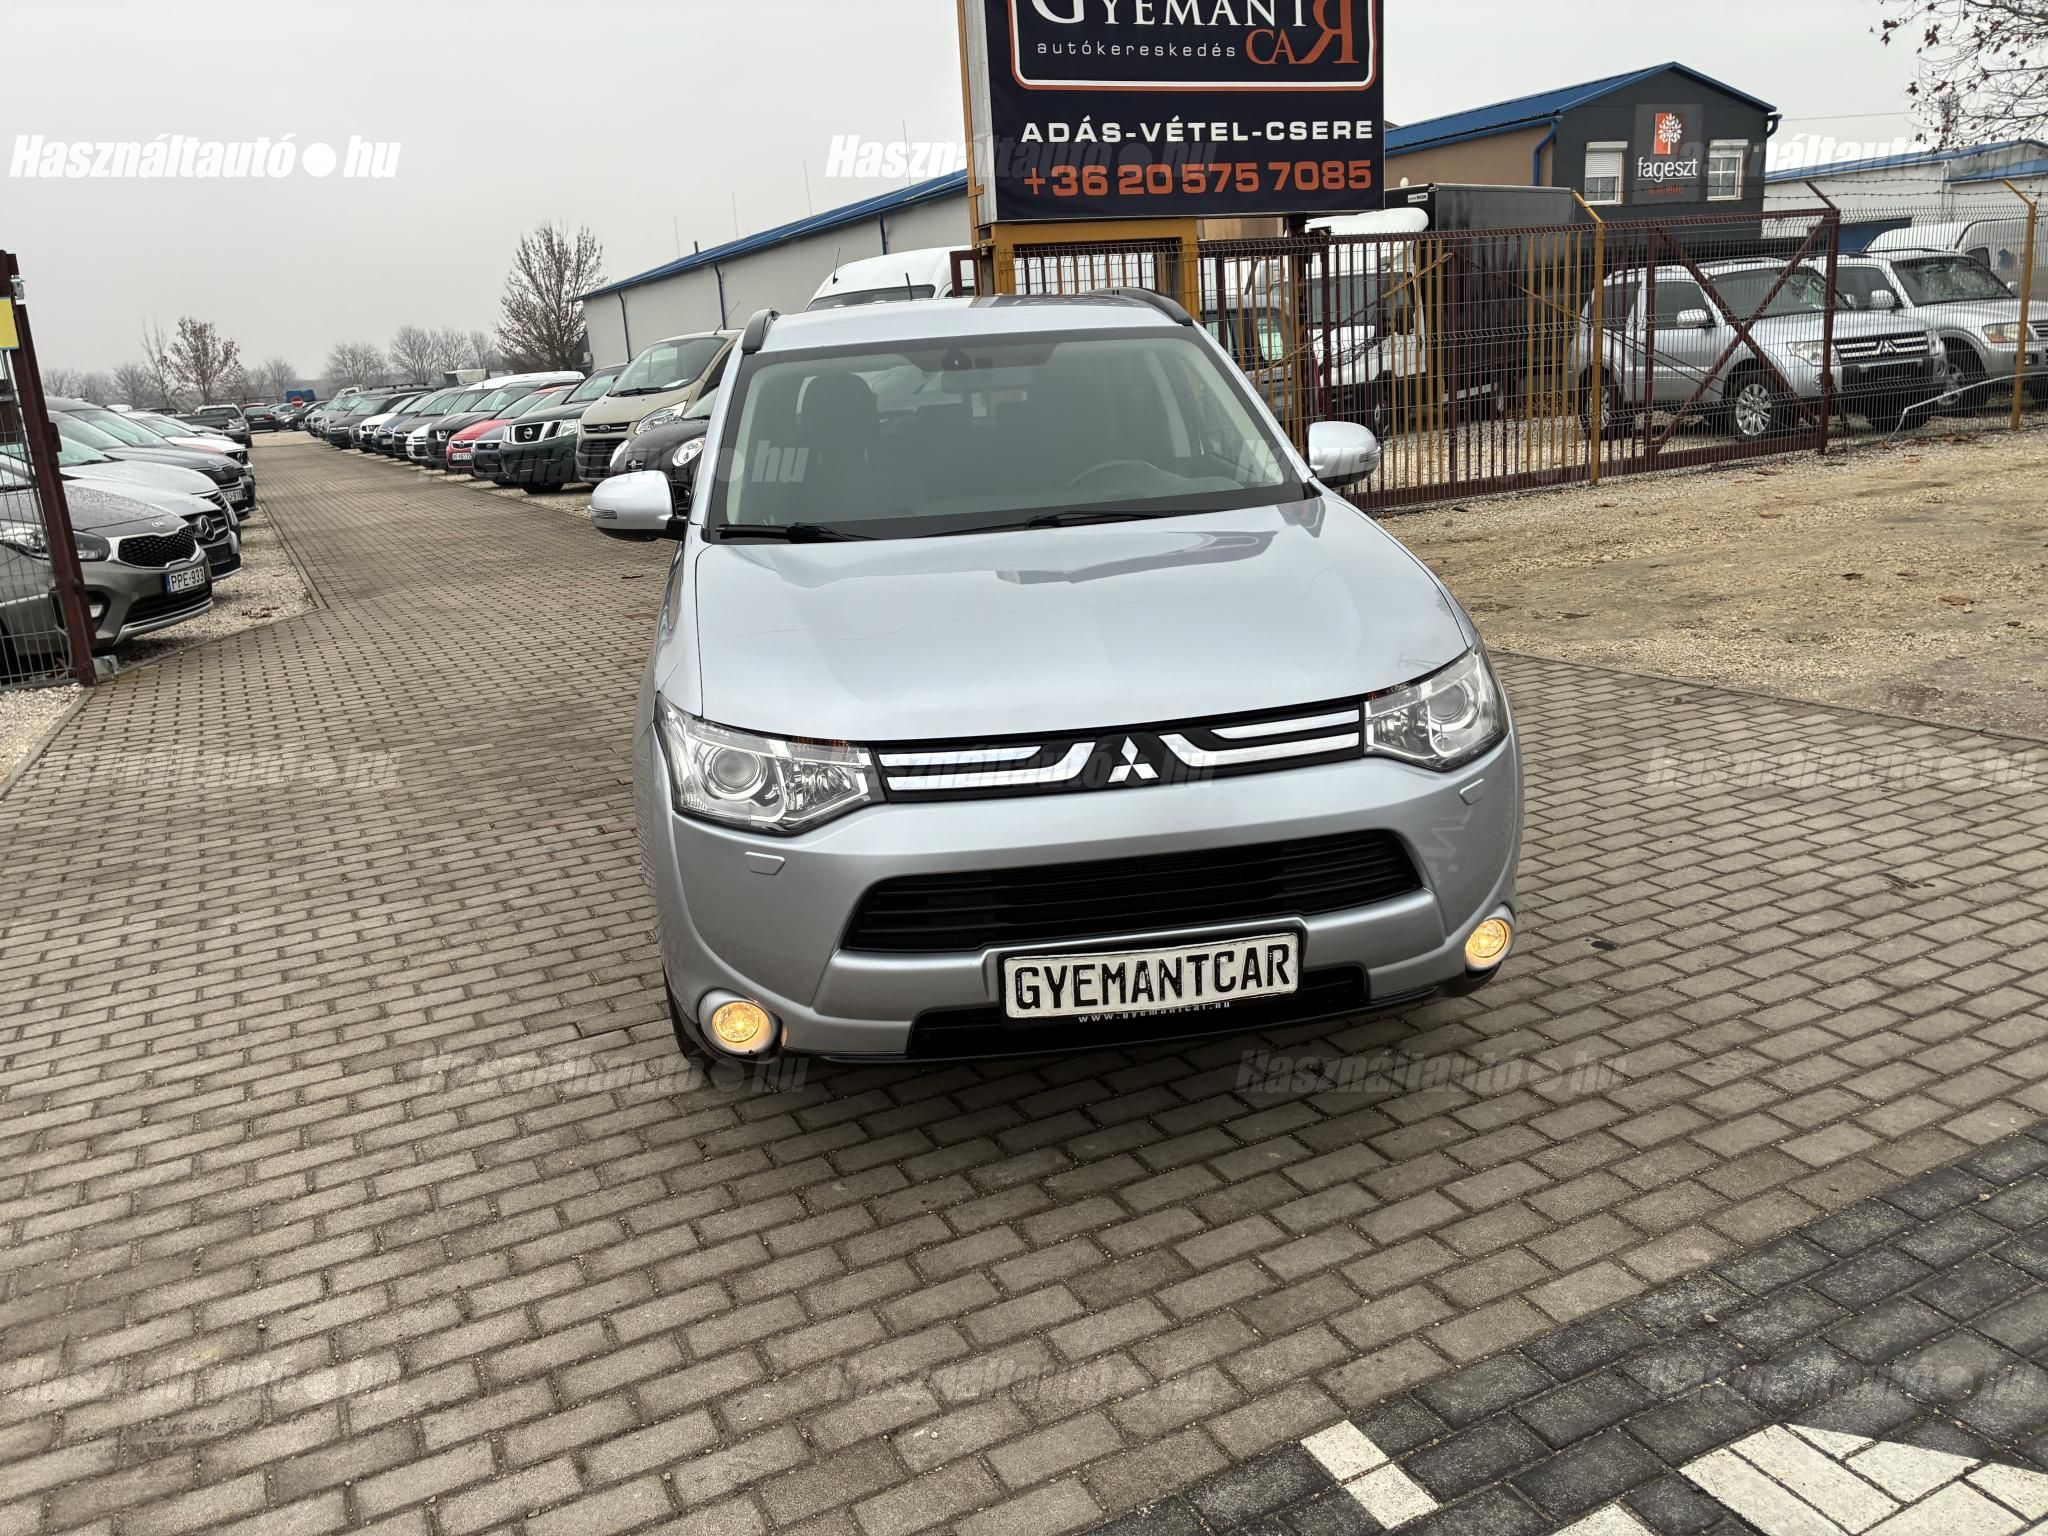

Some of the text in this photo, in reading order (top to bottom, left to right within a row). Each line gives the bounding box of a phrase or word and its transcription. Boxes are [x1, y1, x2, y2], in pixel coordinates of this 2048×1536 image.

[1036, 40, 1236, 57] autókereskedés
[1020, 116, 1374, 144] ADÁS-VÉTEL-CSERE
[1023, 159, 1372, 197] +36 20 575 7085
[1636, 156, 1698, 183] fageszt
[1013, 943, 1291, 1011] GYEMANTCAR
